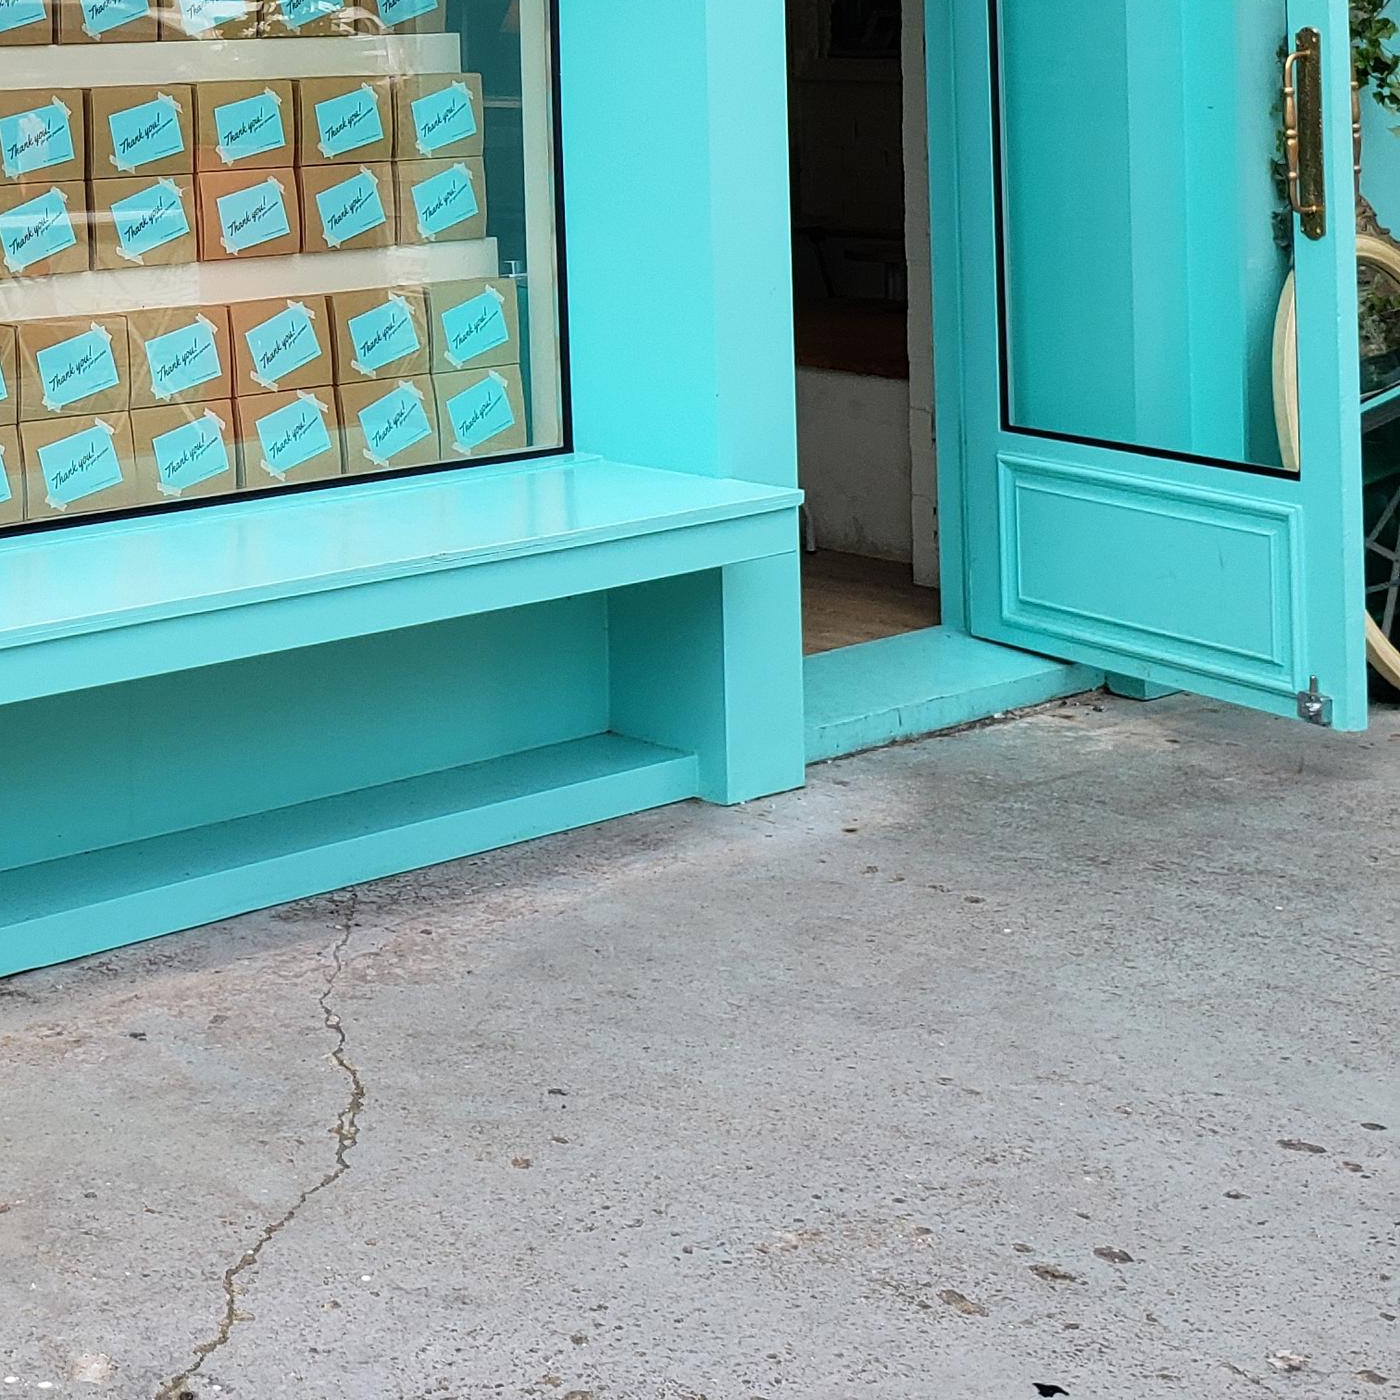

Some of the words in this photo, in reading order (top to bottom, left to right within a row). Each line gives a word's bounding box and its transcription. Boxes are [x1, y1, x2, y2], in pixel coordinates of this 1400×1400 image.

[120, 128, 145, 154] Thank
[144, 112, 160, 138] you!
[224, 122, 248, 146] Thank
[247, 106, 262, 132] you!
[325, 116, 348, 141] Thank
[348, 101, 361, 128] you!
[421, 112, 443, 137] Thank
[443, 97, 455, 123] you!
[8, 134, 34, 160] Thank
[34, 119, 50, 146] you!
[124, 214, 149, 242] Thank
[149, 196, 162, 225] you!
[228, 211, 252, 236] Thank
[252, 195, 266, 222] you!
[327, 204, 350, 230] Thank
[350, 187, 362, 214] you!
[422, 195, 444, 221] Thank
[443, 179, 456, 206] you!
[9, 227, 34, 255] Thank
[33, 207, 48, 237] you!
[260, 339, 282, 369] Thank
[281, 321, 295, 350] you!
[360, 330, 382, 357] Thank
[382, 312, 396, 341] you!
[452, 323, 474, 349] Thank
[474, 306, 487, 333] you!
[49, 363, 76, 391] Thank
[76, 345, 92, 375] you!
[157, 354, 182, 381] Thank
[181, 337, 197, 366] you!
[269, 429, 292, 459] Thank
[292, 412, 305, 440] you!
[372, 419, 394, 447] Thank
[393, 400, 405, 428] you!
[459, 409, 480, 436] Thank
[479, 391, 491, 419] you!
[51, 460, 78, 489] Thank
[78, 441, 94, 471] you!
[165, 450, 190, 478] Thank
[189, 432, 205, 461] you!
